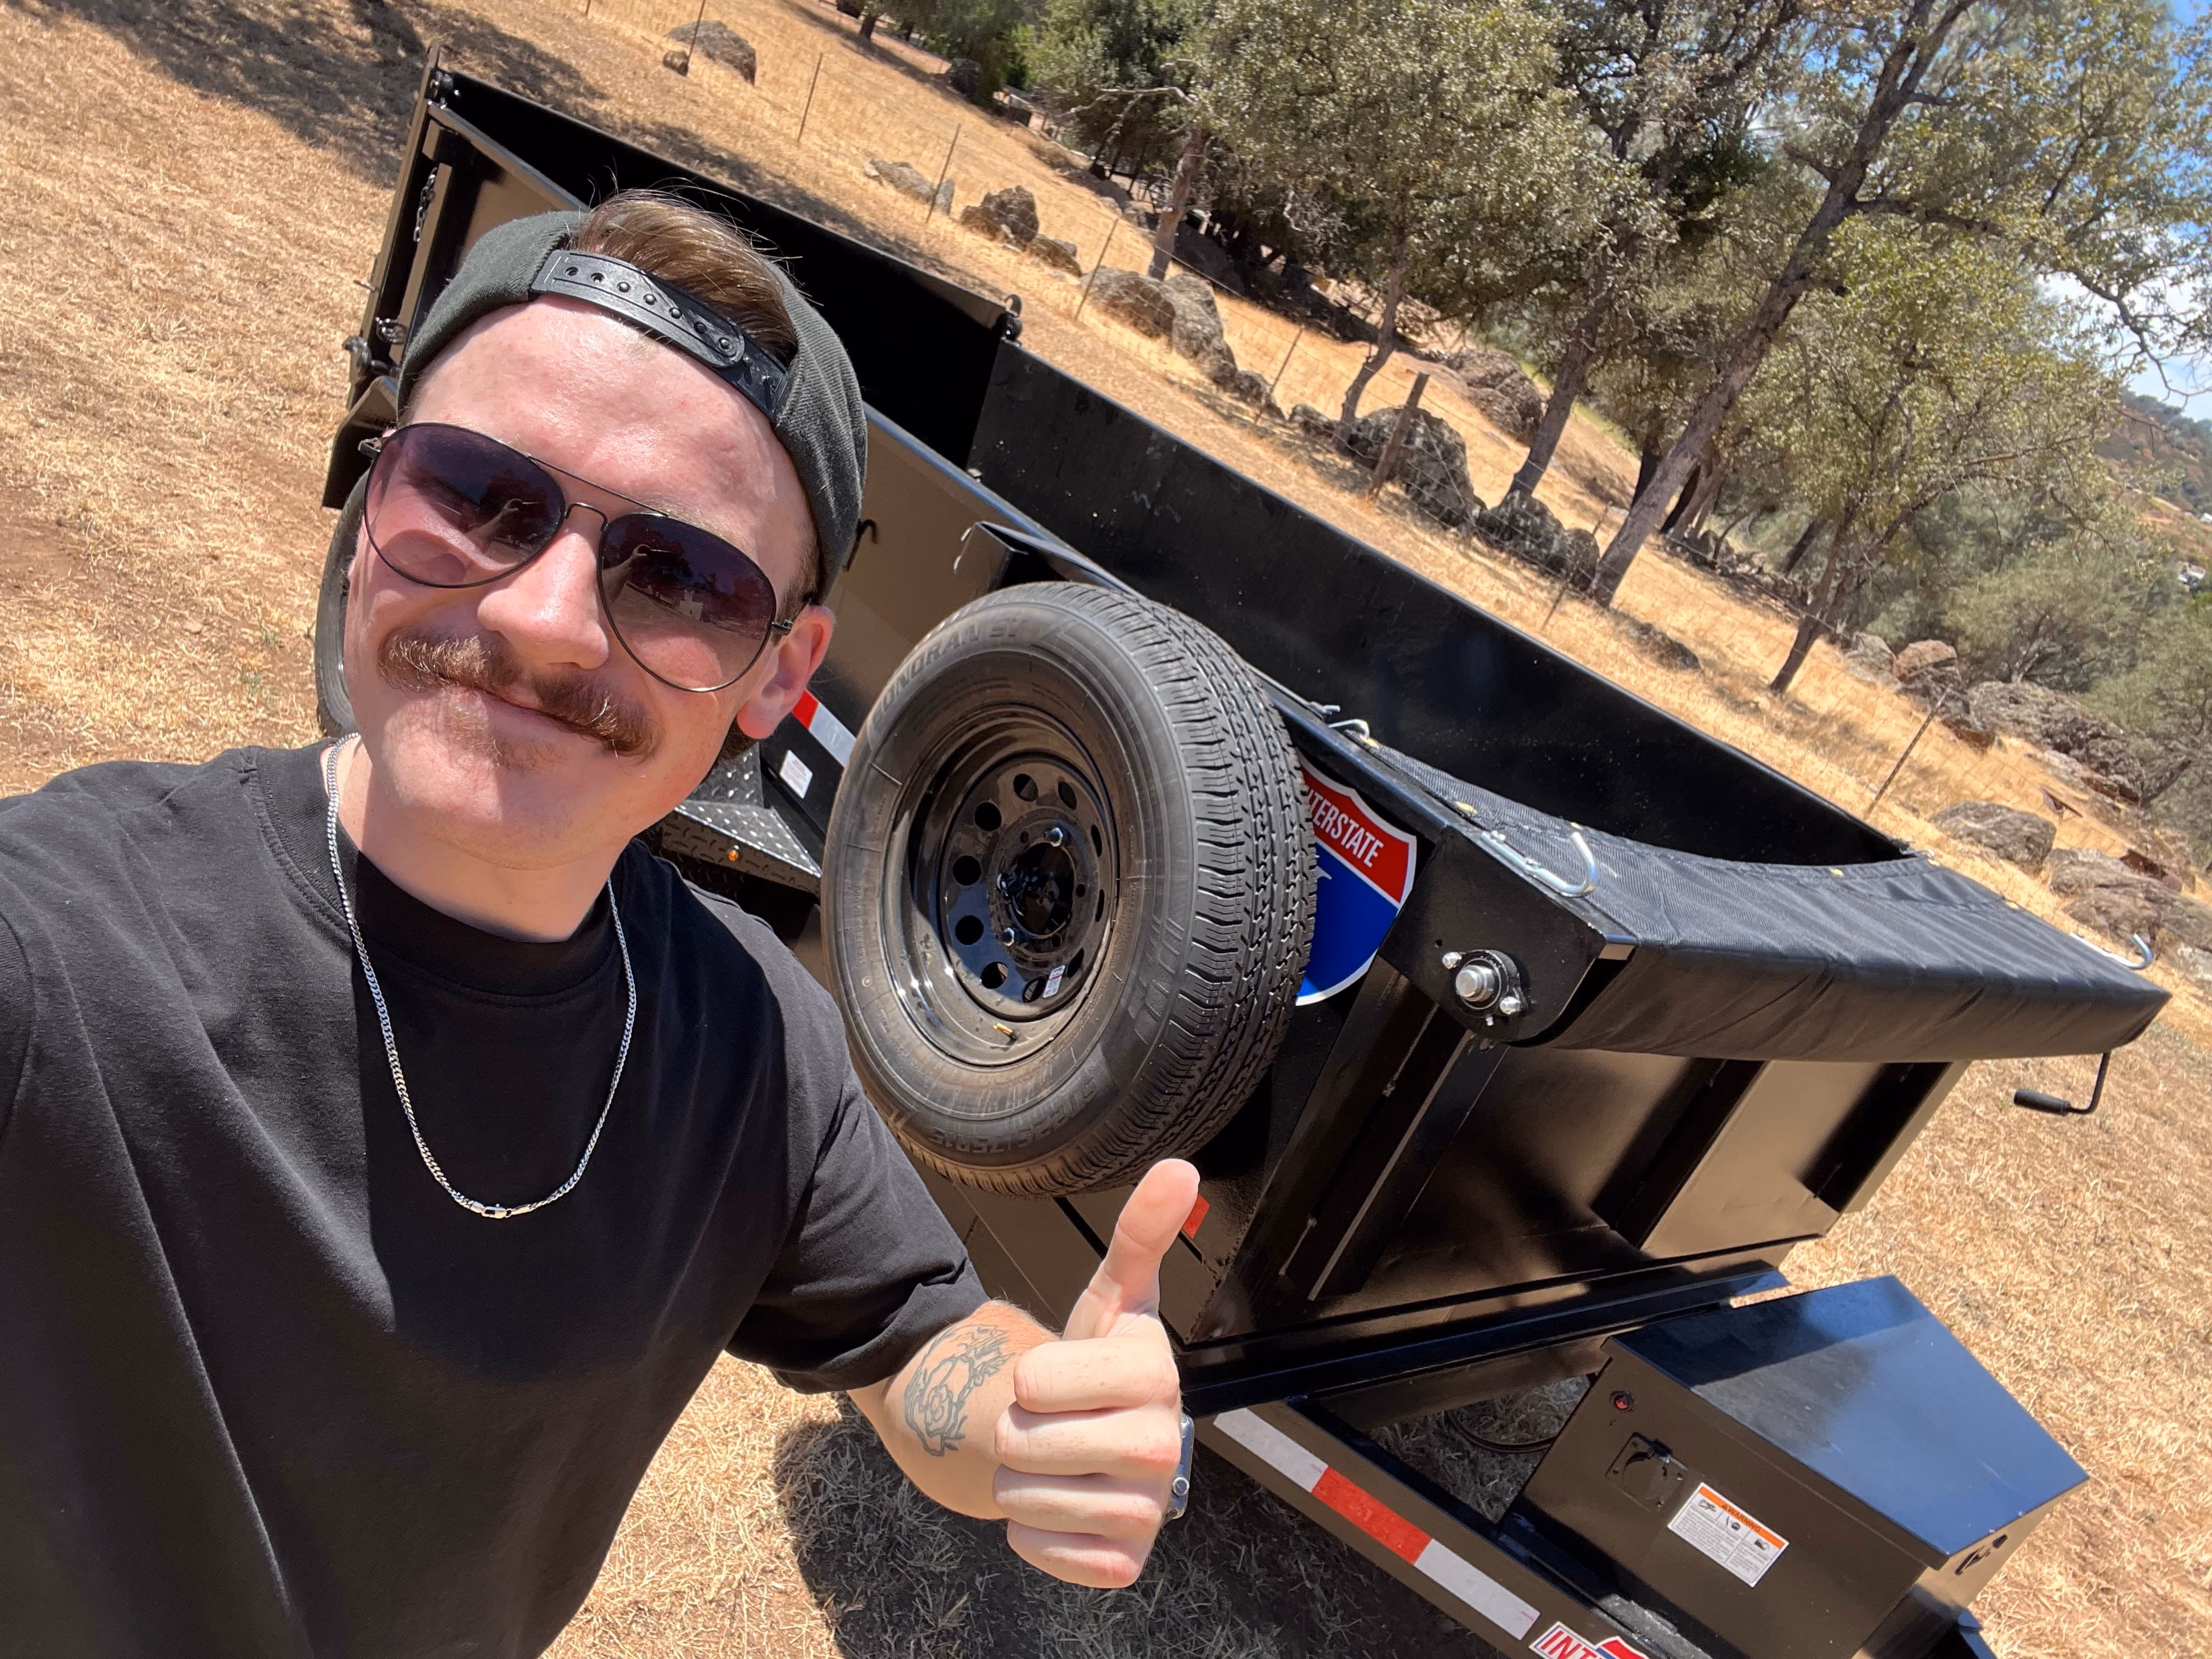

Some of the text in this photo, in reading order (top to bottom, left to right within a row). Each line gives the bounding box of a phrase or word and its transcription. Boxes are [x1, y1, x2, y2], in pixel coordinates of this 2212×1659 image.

[1307, 789, 1384, 868] TERSTATE
[1726, 1506, 1760, 1532] WARNING
[1540, 1630, 1604, 1659] INT
